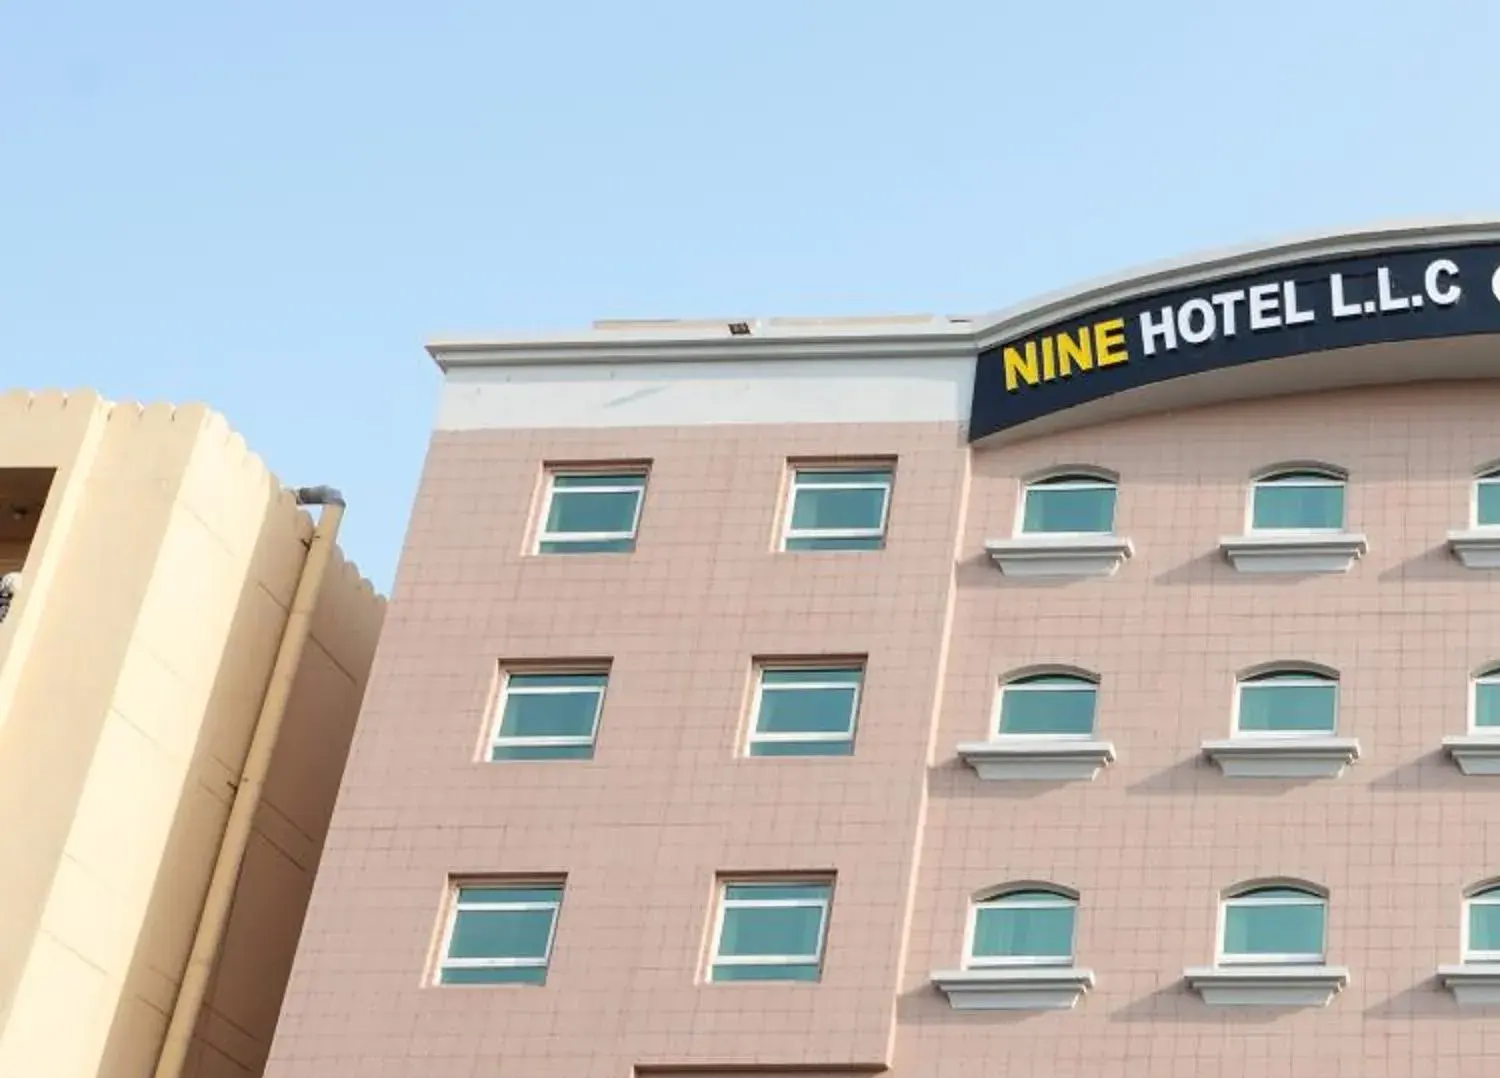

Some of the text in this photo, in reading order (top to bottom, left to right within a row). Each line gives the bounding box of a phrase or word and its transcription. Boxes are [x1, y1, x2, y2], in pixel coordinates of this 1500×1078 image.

[1002, 259, 1462, 391] NINE HOTEL L.L.C
